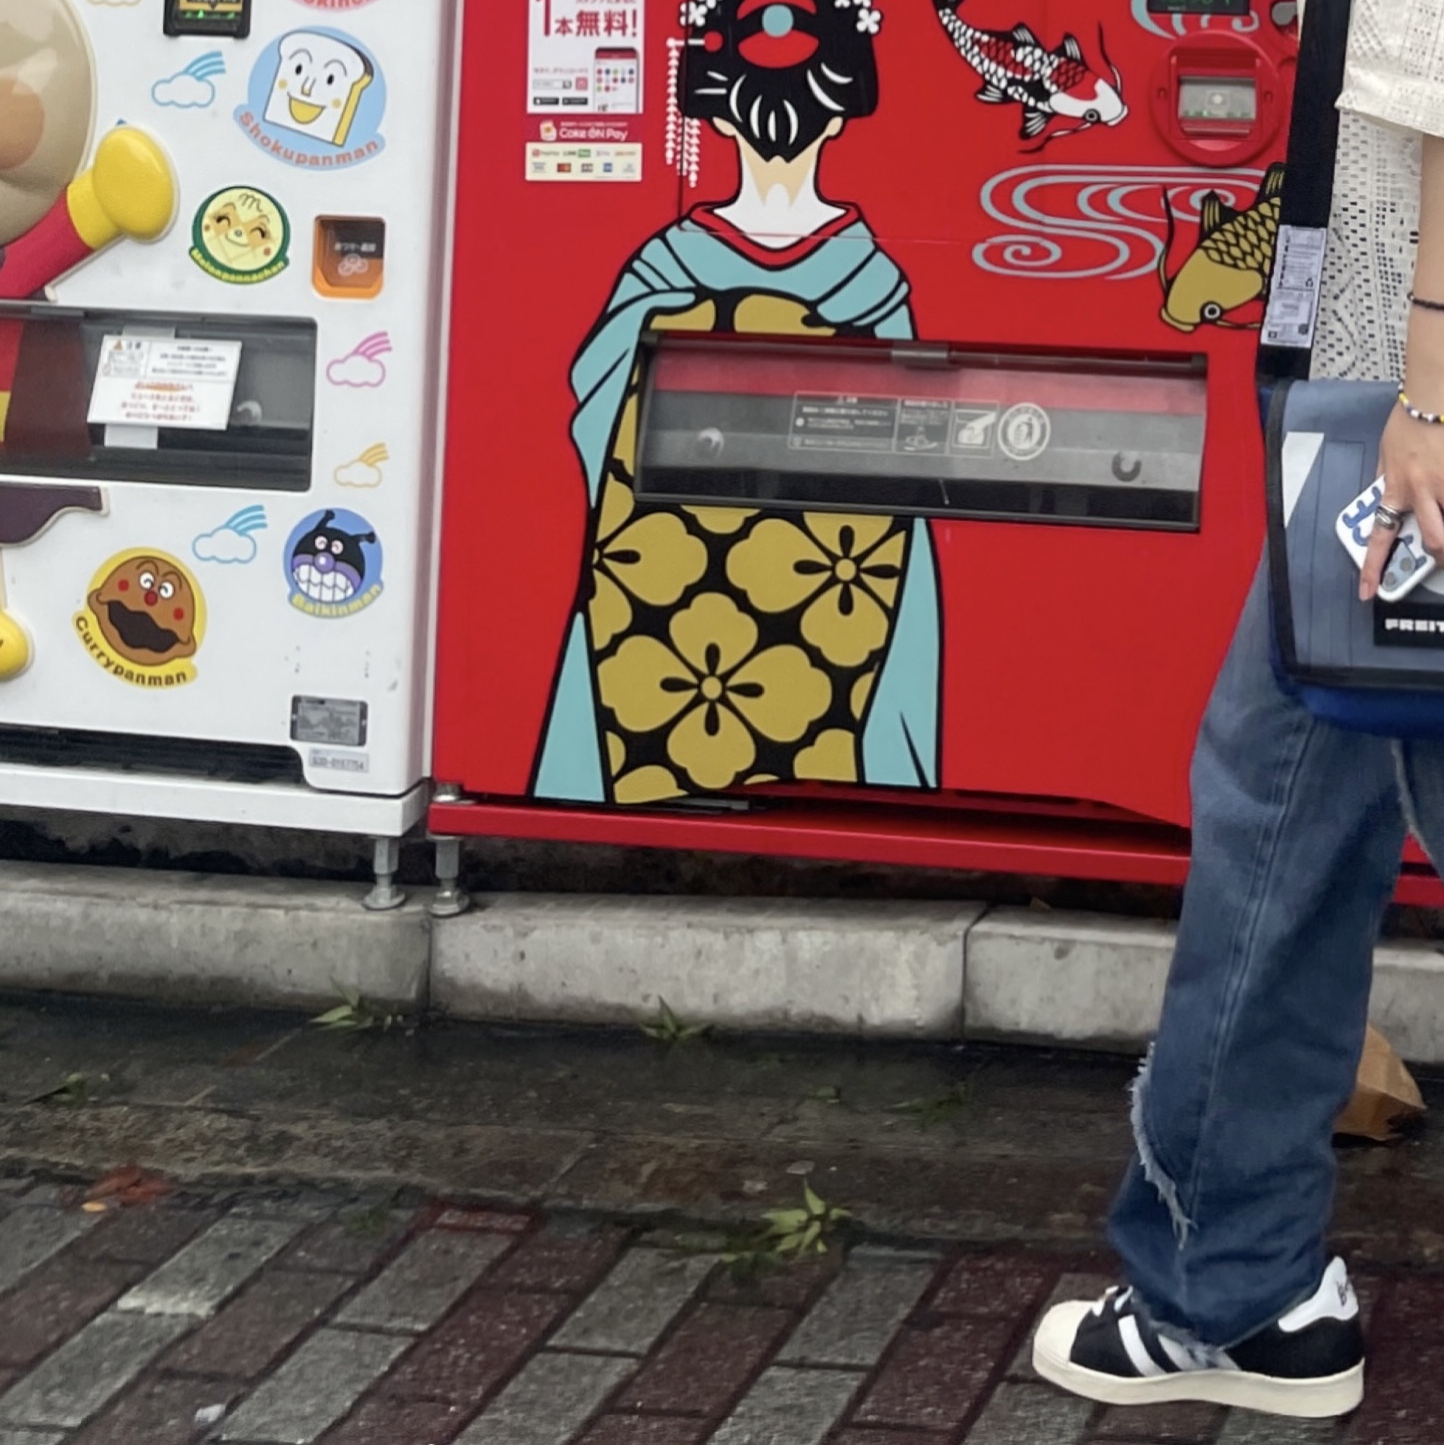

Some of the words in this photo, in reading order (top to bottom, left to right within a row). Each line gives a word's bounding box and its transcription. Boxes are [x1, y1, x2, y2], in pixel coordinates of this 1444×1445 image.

[238, 111, 379, 168] Shokupanman
[559, 127, 587, 140] Coke
[606, 127, 628, 142] Pay
[291, 583, 380, 618] Baikinman
[74, 613, 188, 688] Currypanman
